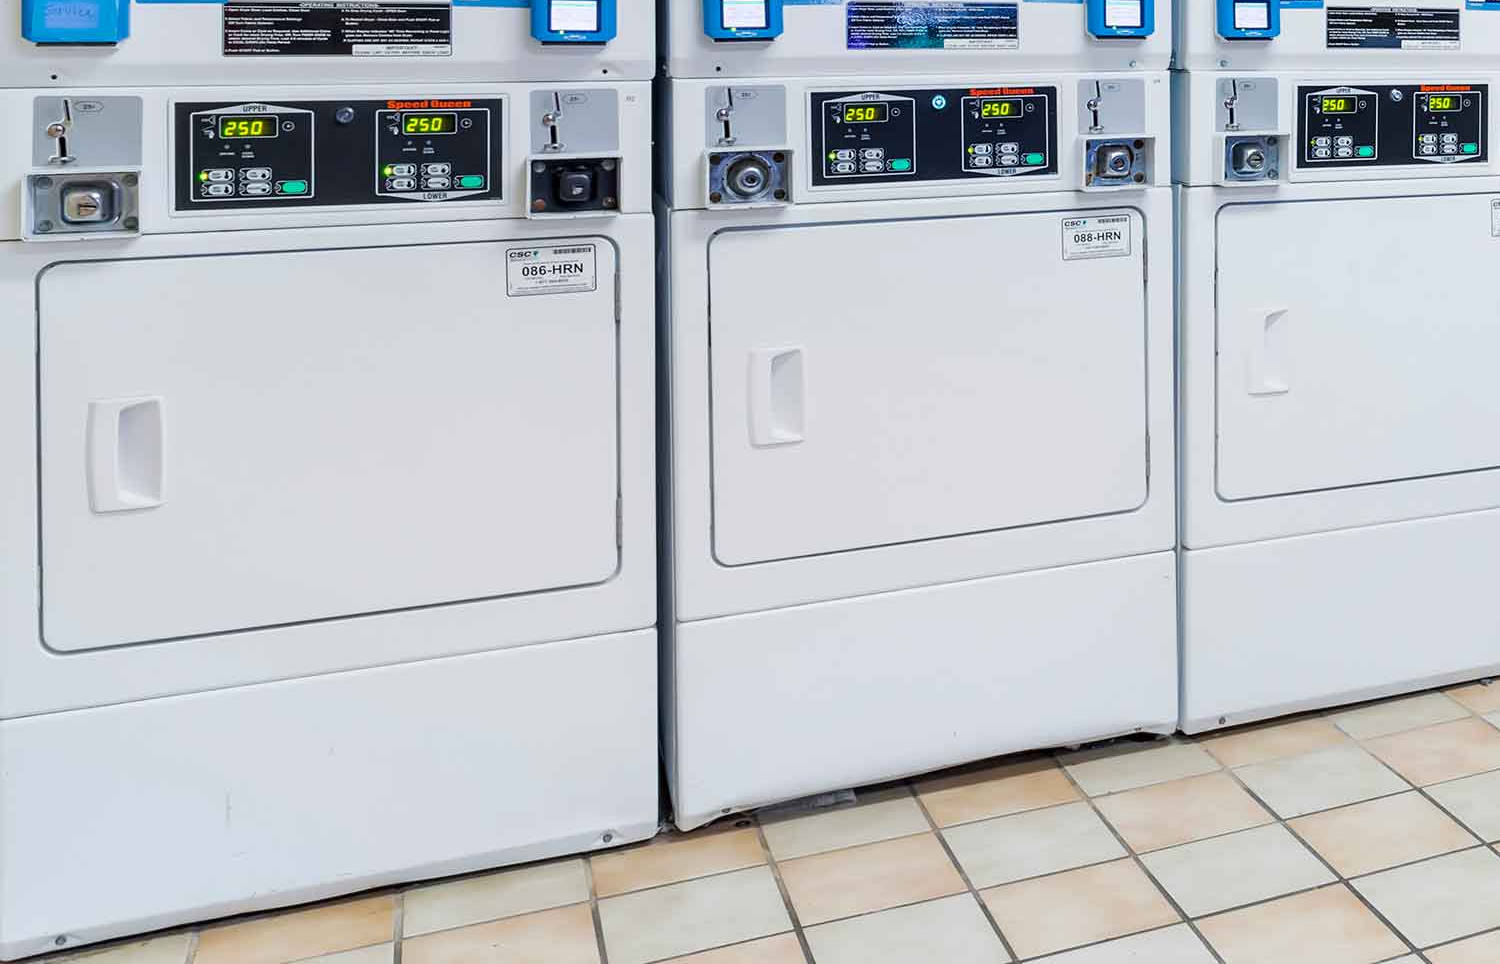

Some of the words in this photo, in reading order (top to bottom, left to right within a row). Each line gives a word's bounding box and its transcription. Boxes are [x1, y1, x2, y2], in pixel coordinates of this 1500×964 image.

[970, 88, 1001, 96] Speed
[1002, 87, 1034, 95] Queen
[386, 100, 429, 110] Speed
[430, 100, 472, 108] Queen
[982, 103, 1010, 116] 250
[1323, 99, 1345, 111] 250
[1430, 98, 1450, 109] 250
[845, 107, 875, 121] 250
[224, 121, 264, 136] 250
[406, 118, 442, 132] 250
[1074, 230, 1121, 244] 088-HRN
[509, 250, 532, 258] CSC
[522, 262, 584, 276] 086-HRN
